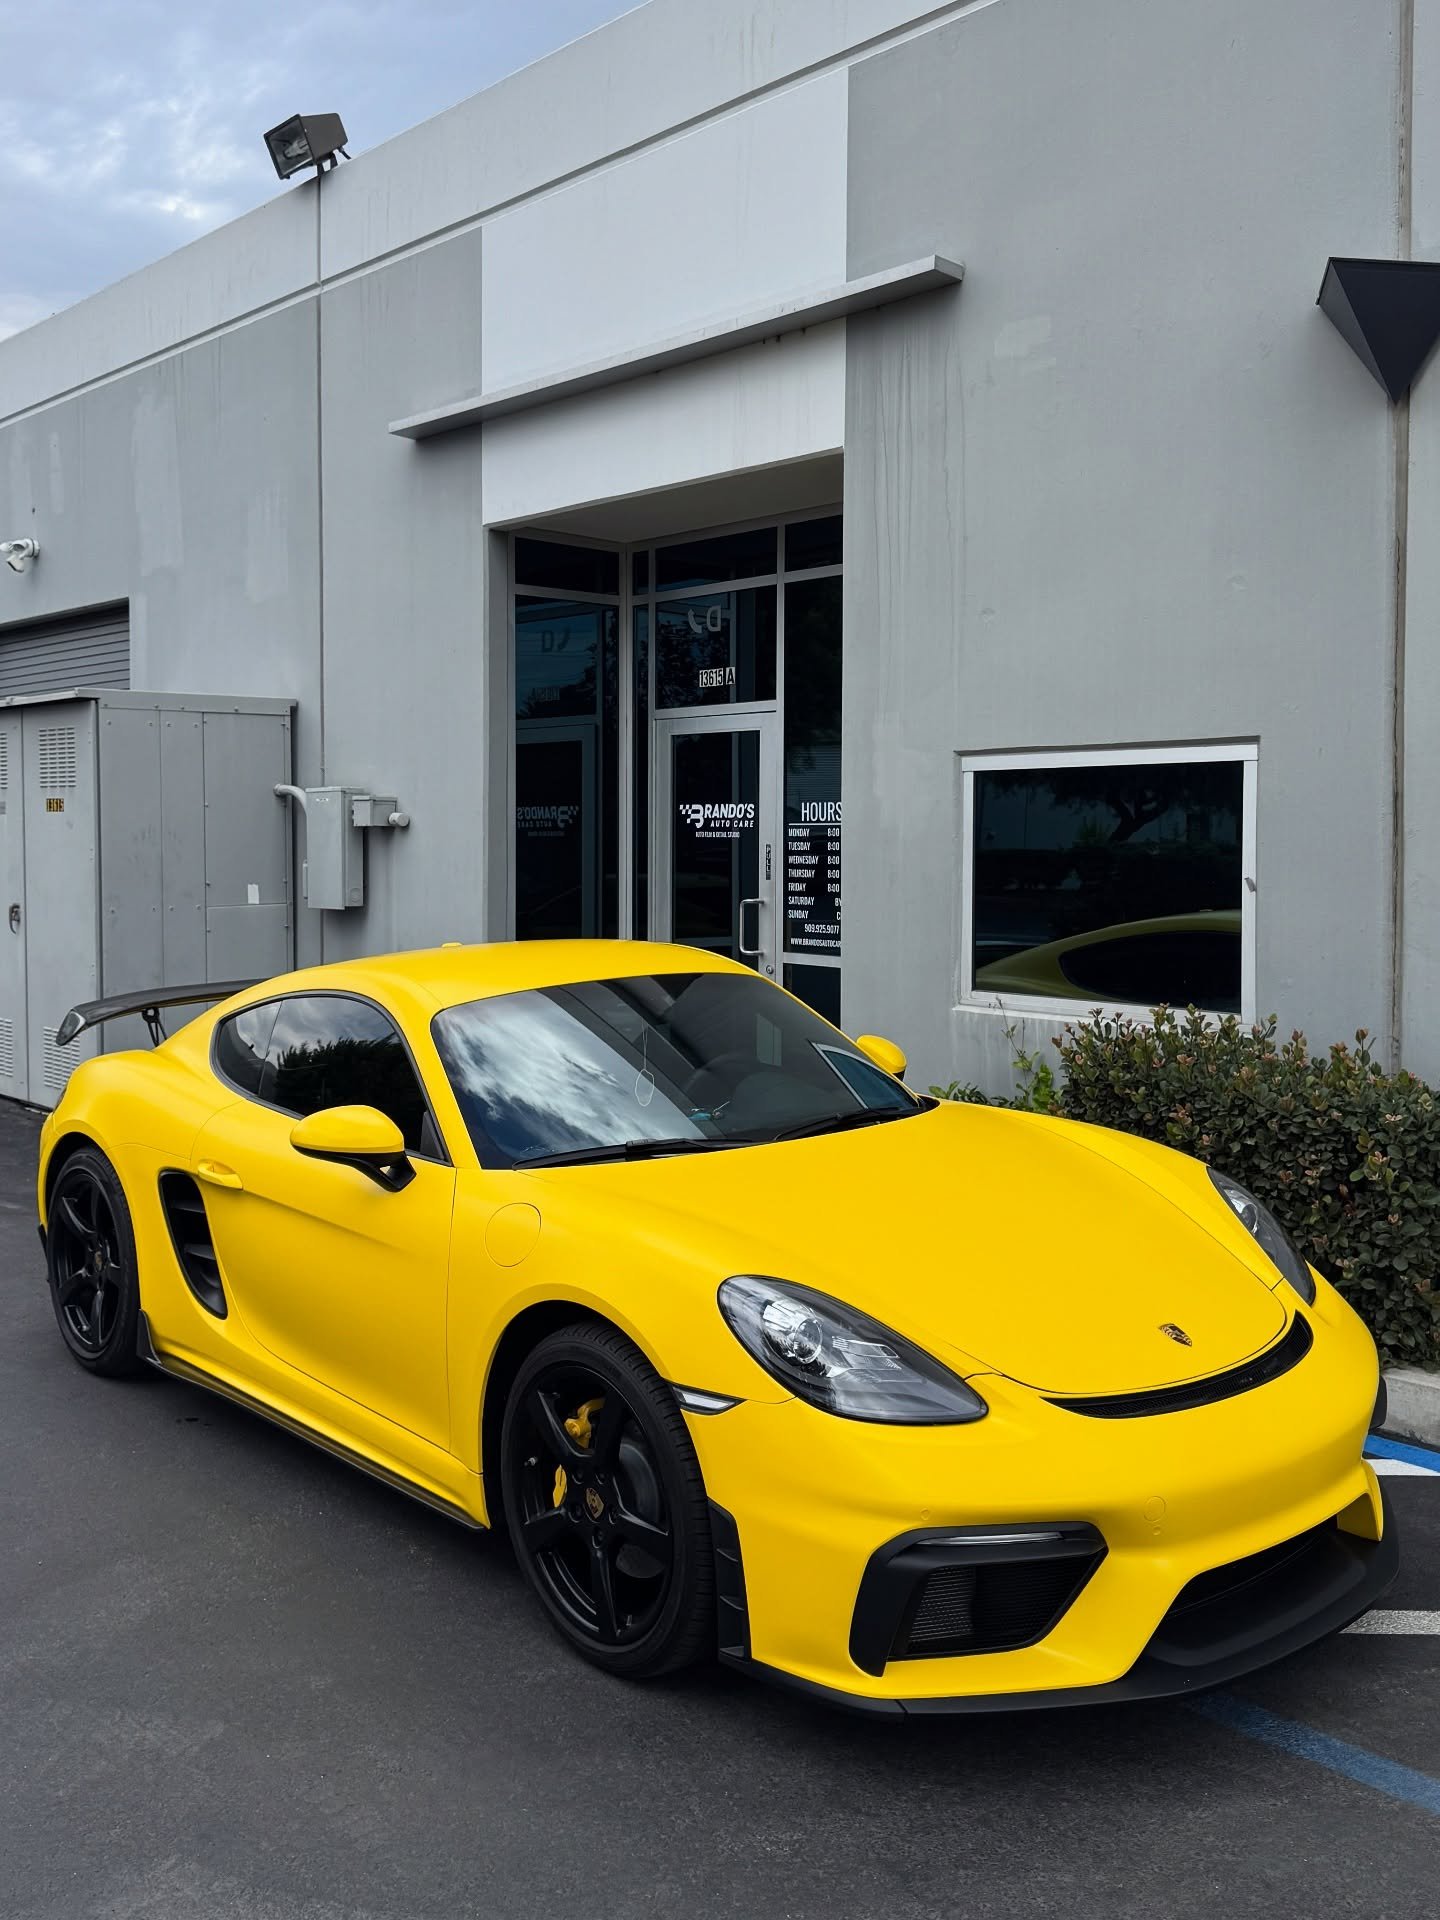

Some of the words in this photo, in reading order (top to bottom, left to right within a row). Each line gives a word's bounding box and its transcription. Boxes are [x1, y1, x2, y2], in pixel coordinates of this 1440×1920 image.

[699, 668, 723, 687] 13615
[726, 667, 735, 685] A
[680, 803, 755, 829] BRANDO'S
[801, 802, 842, 822] HOURS
[710, 820, 730, 828] AUTO
[733, 820, 754, 828] CARE
[788, 828, 810, 837] MONDAY
[827, 828, 840, 837] 8:00
[788, 841, 811, 851] TUESDAY
[827, 841, 840, 851] 8:00
[788, 855, 819, 865] WEDNESDAY
[827, 855, 840, 865] 8:00
[788, 868, 815, 878] THURSDAY
[827, 869, 840, 878] 8:00
[788, 882, 807, 892] FRIDAY
[827, 883, 840, 893] 8:00
[788, 896, 815, 906] SATURDAY
[788, 909, 809, 919] SUNDAY
[804, 923, 840, 935] 909.925.9077
